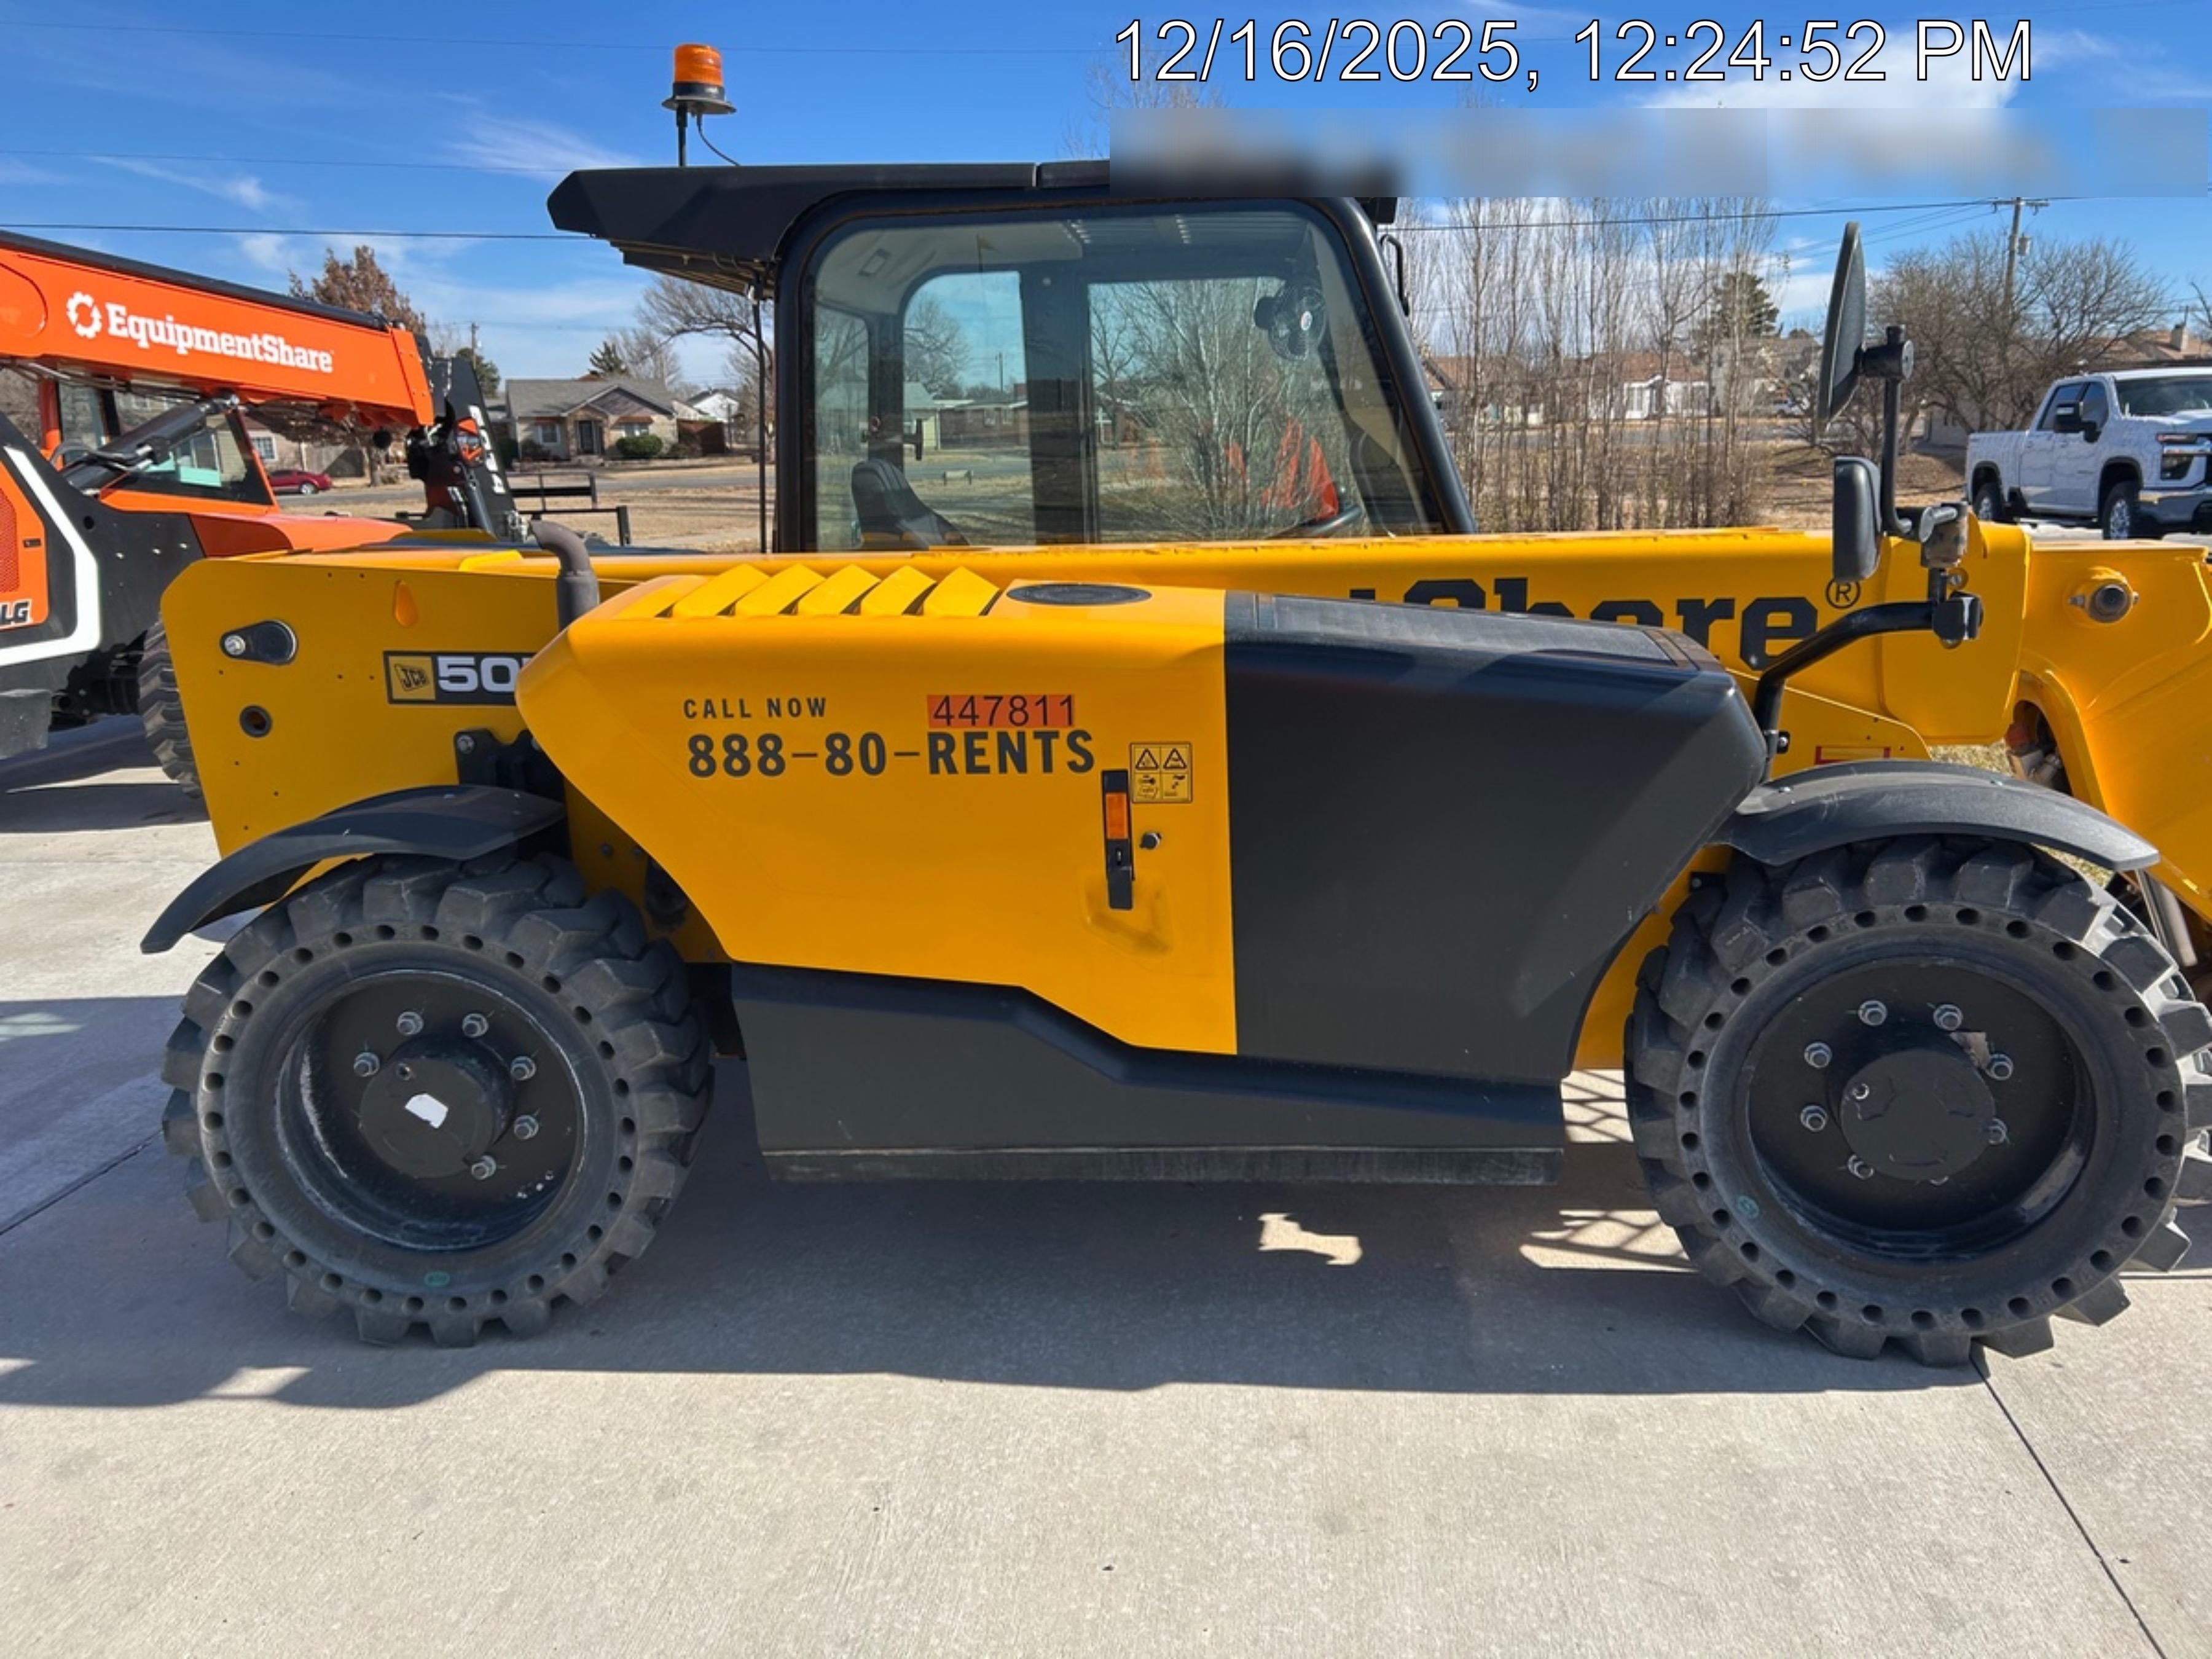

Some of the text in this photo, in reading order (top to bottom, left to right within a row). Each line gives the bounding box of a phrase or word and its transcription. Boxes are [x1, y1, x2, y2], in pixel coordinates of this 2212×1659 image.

[104, 302, 334, 373] EquipmentShare
[0, 600, 31, 626] LG
[437, 656, 531, 692] 50
[683, 697, 826, 719] CALL NOW
[931, 694, 1075, 727] 447811
[688, 729, 1095, 777] 888-80-RENTS
